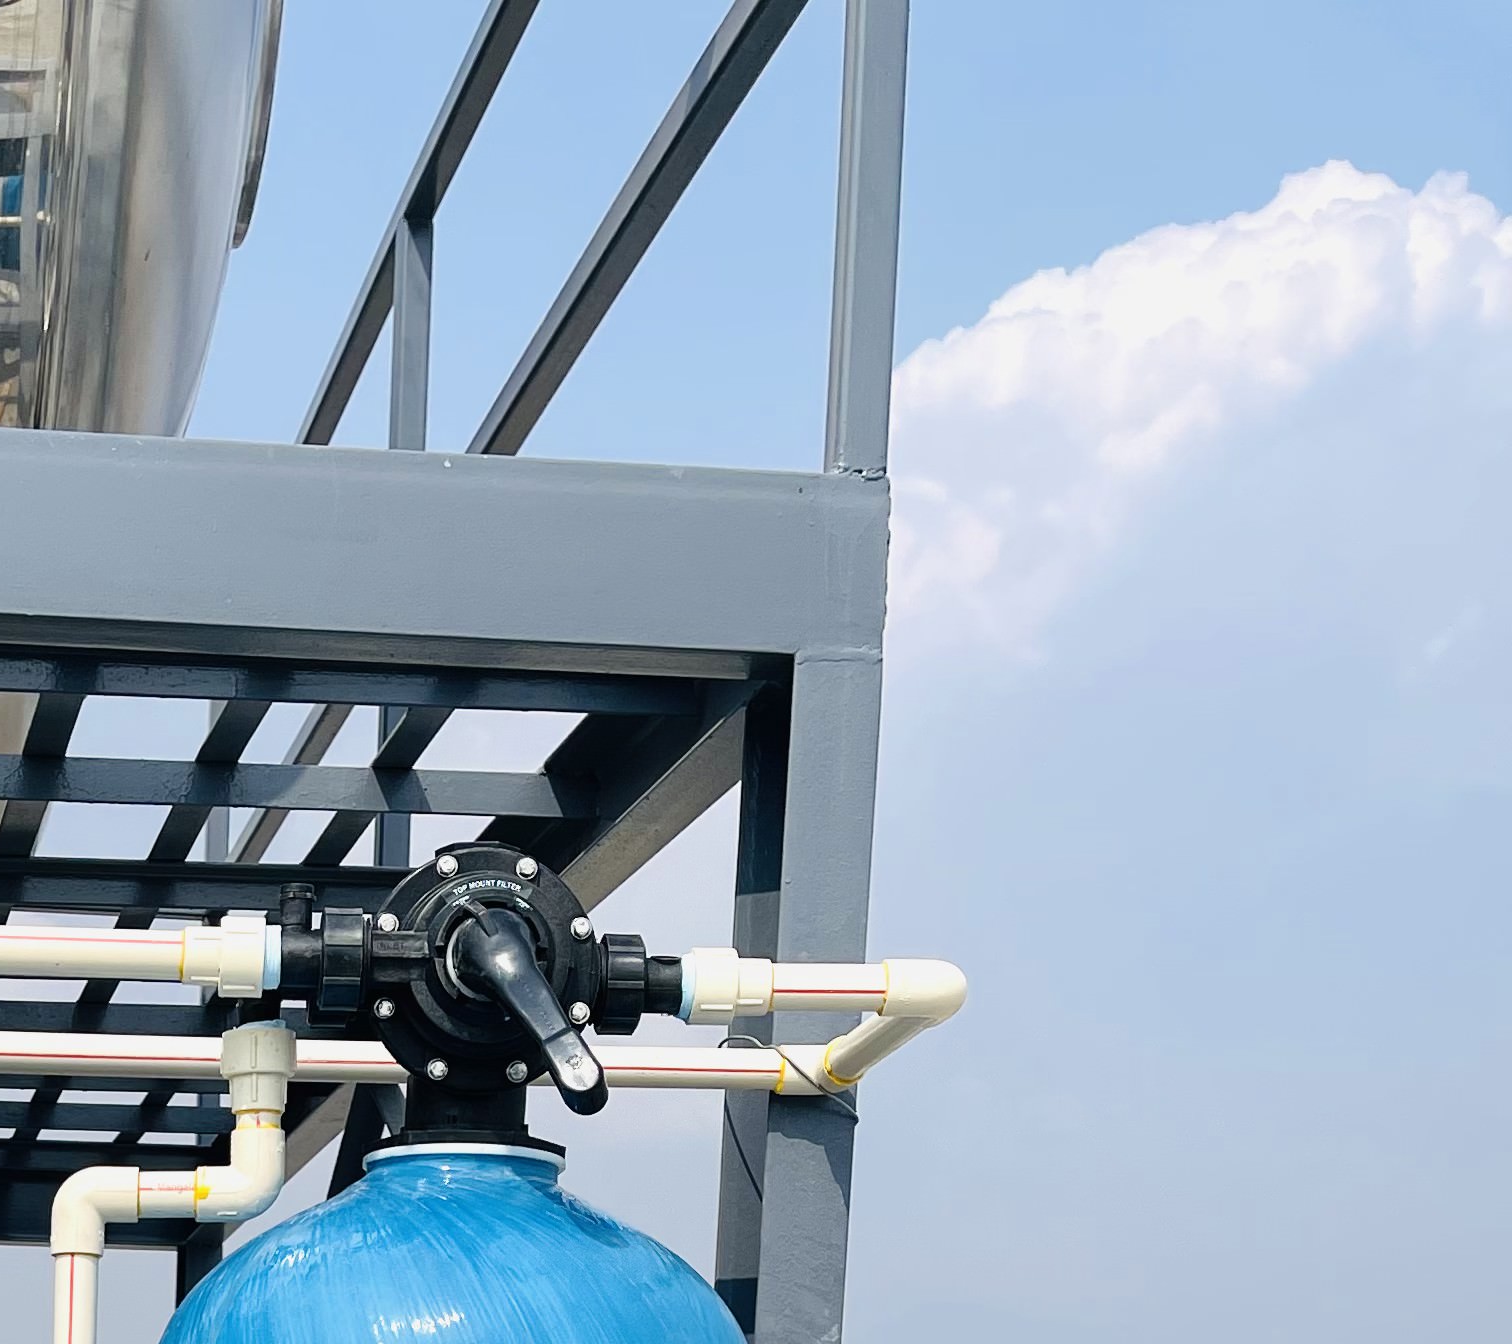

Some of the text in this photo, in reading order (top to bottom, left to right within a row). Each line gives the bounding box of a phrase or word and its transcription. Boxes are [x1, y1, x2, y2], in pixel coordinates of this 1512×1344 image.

[452, 879, 522, 896] TOP MOUNT FILTER
